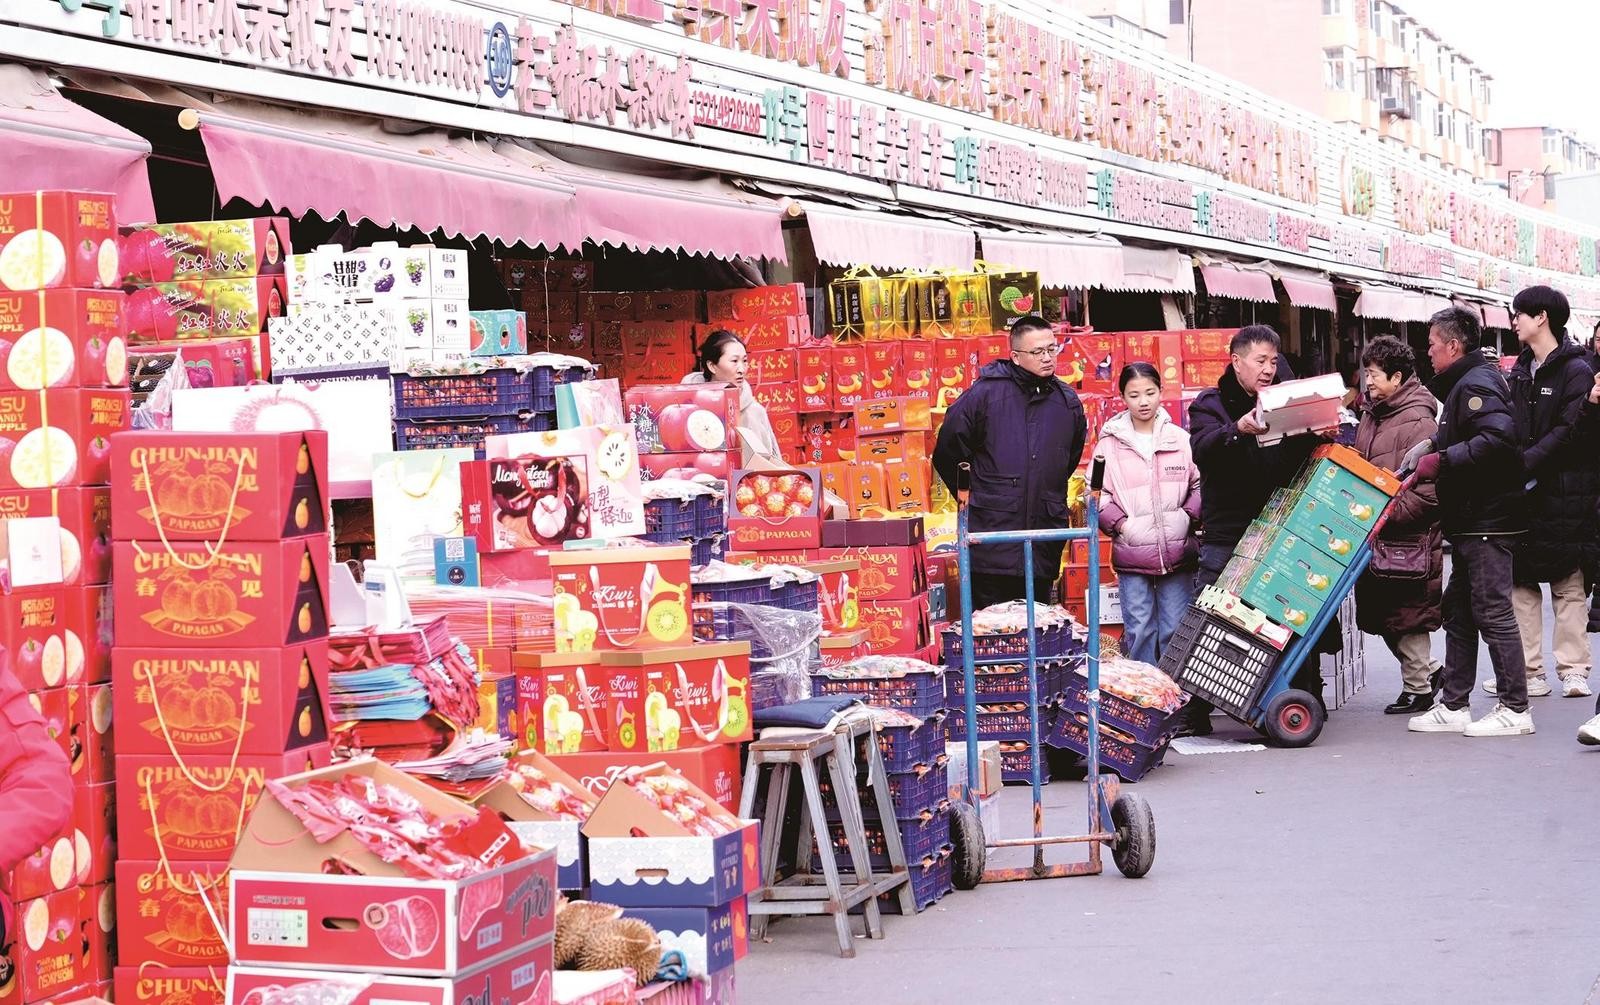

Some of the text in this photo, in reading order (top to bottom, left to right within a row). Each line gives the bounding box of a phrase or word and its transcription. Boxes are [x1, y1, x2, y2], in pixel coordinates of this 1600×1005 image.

[693, 90, 761, 134] 13214920188
[130, 447, 257, 469] CHUNJIAN
[169, 518, 221, 530] PAPAGAN
[766, 530, 812, 539] PAPAGAN
[135, 577, 264, 598] 春 见
[590, 585, 635, 602] Kiwi
[172, 623, 224, 635] PAPAGAN
[132, 659, 260, 682] CHUNJIAN
[172, 730, 223, 741] PAPAGAN
[176, 836, 228, 849] PAPAGAN
[138, 898, 161, 918] 春
